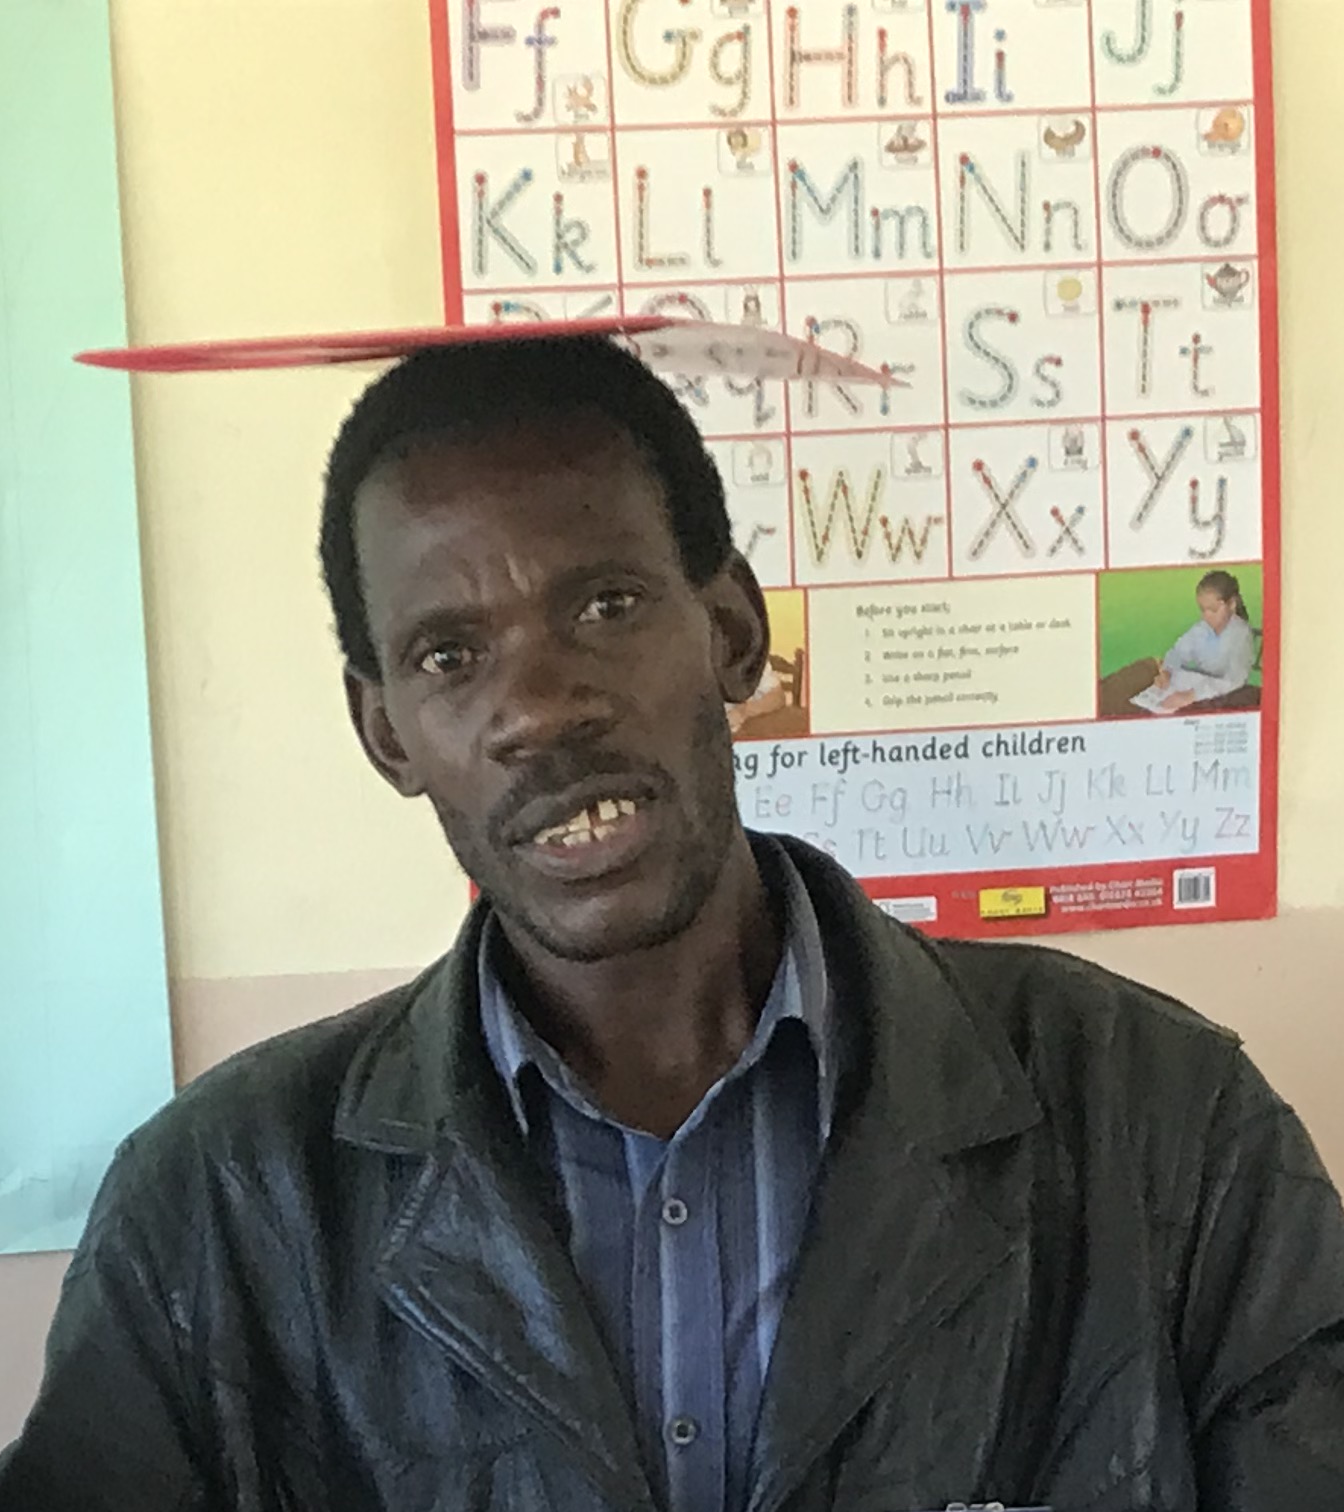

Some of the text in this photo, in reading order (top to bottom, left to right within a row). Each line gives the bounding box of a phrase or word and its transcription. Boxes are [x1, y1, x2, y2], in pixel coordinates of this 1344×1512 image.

[784, 2, 923, 108] Hh
[944, 0, 1015, 104] Ii
[472, 168, 599, 277] Kk
[632, 164, 724, 272] Ll
[785, 152, 937, 263] Mm
[955, 145, 1088, 256] Nn
[1106, 144, 1250, 253] Oo
[957, 304, 1064, 409] Ss
[1113, 294, 1216, 399] Tt
[796, 463, 945, 570] Ww
[966, 455, 1088, 561] Xx
[1125, 424, 1229, 559] Yy
[755, 785, 793, 818] Ee
[810, 777, 847, 828] Ff
[861, 778, 907, 825] Gg
[931, 770, 975, 809] Hh
[1038, 769, 1067, 815] Jj
[1087, 762, 1127, 799] Kk
[1145, 763, 1175, 796] Ll
[1191, 759, 1252, 793] Mm
[766, 744, 808, 779] for
[819, 735, 969, 774] left-handed
[982, 730, 1086, 758] children
[856, 828, 887, 861] Tt
[902, 826, 950, 858] Uu
[965, 822, 1013, 856] Vv
[1022, 817, 1096, 852] Ww
[1106, 814, 1145, 846] Xx
[1159, 809, 1200, 853] Yy
[1215, 806, 1252, 839] Zz
